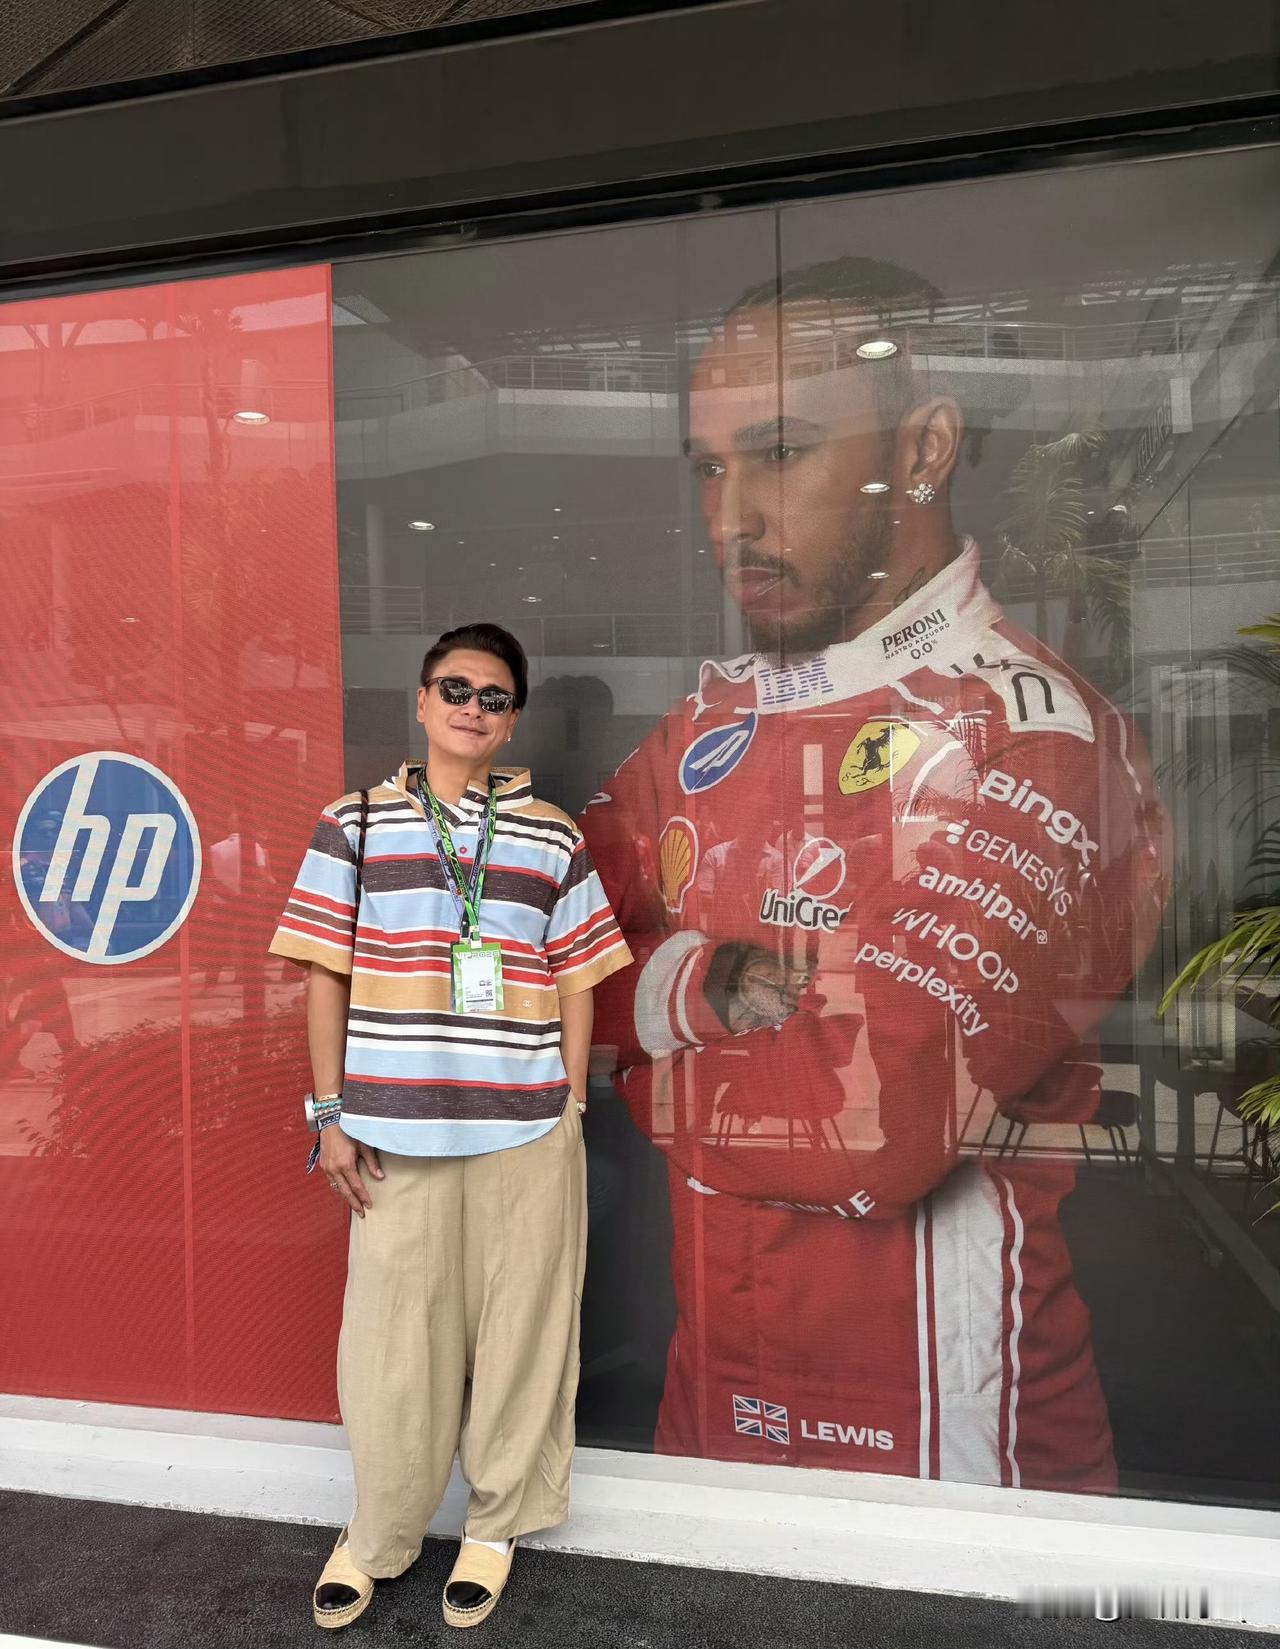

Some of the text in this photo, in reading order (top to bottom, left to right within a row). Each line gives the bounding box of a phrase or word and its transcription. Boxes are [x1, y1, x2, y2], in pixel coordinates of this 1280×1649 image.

[881, 609, 947, 653] PERONI
[885, 642, 913, 660] NASTRO
[758, 657, 834, 705] IBM
[39, 757, 177, 957] hp
[965, 829, 1072, 917] GENESYS
[891, 908, 1019, 994] WHOOP
[853, 943, 990, 1037] perplexity
[800, 1419, 894, 1451] LEWIS
